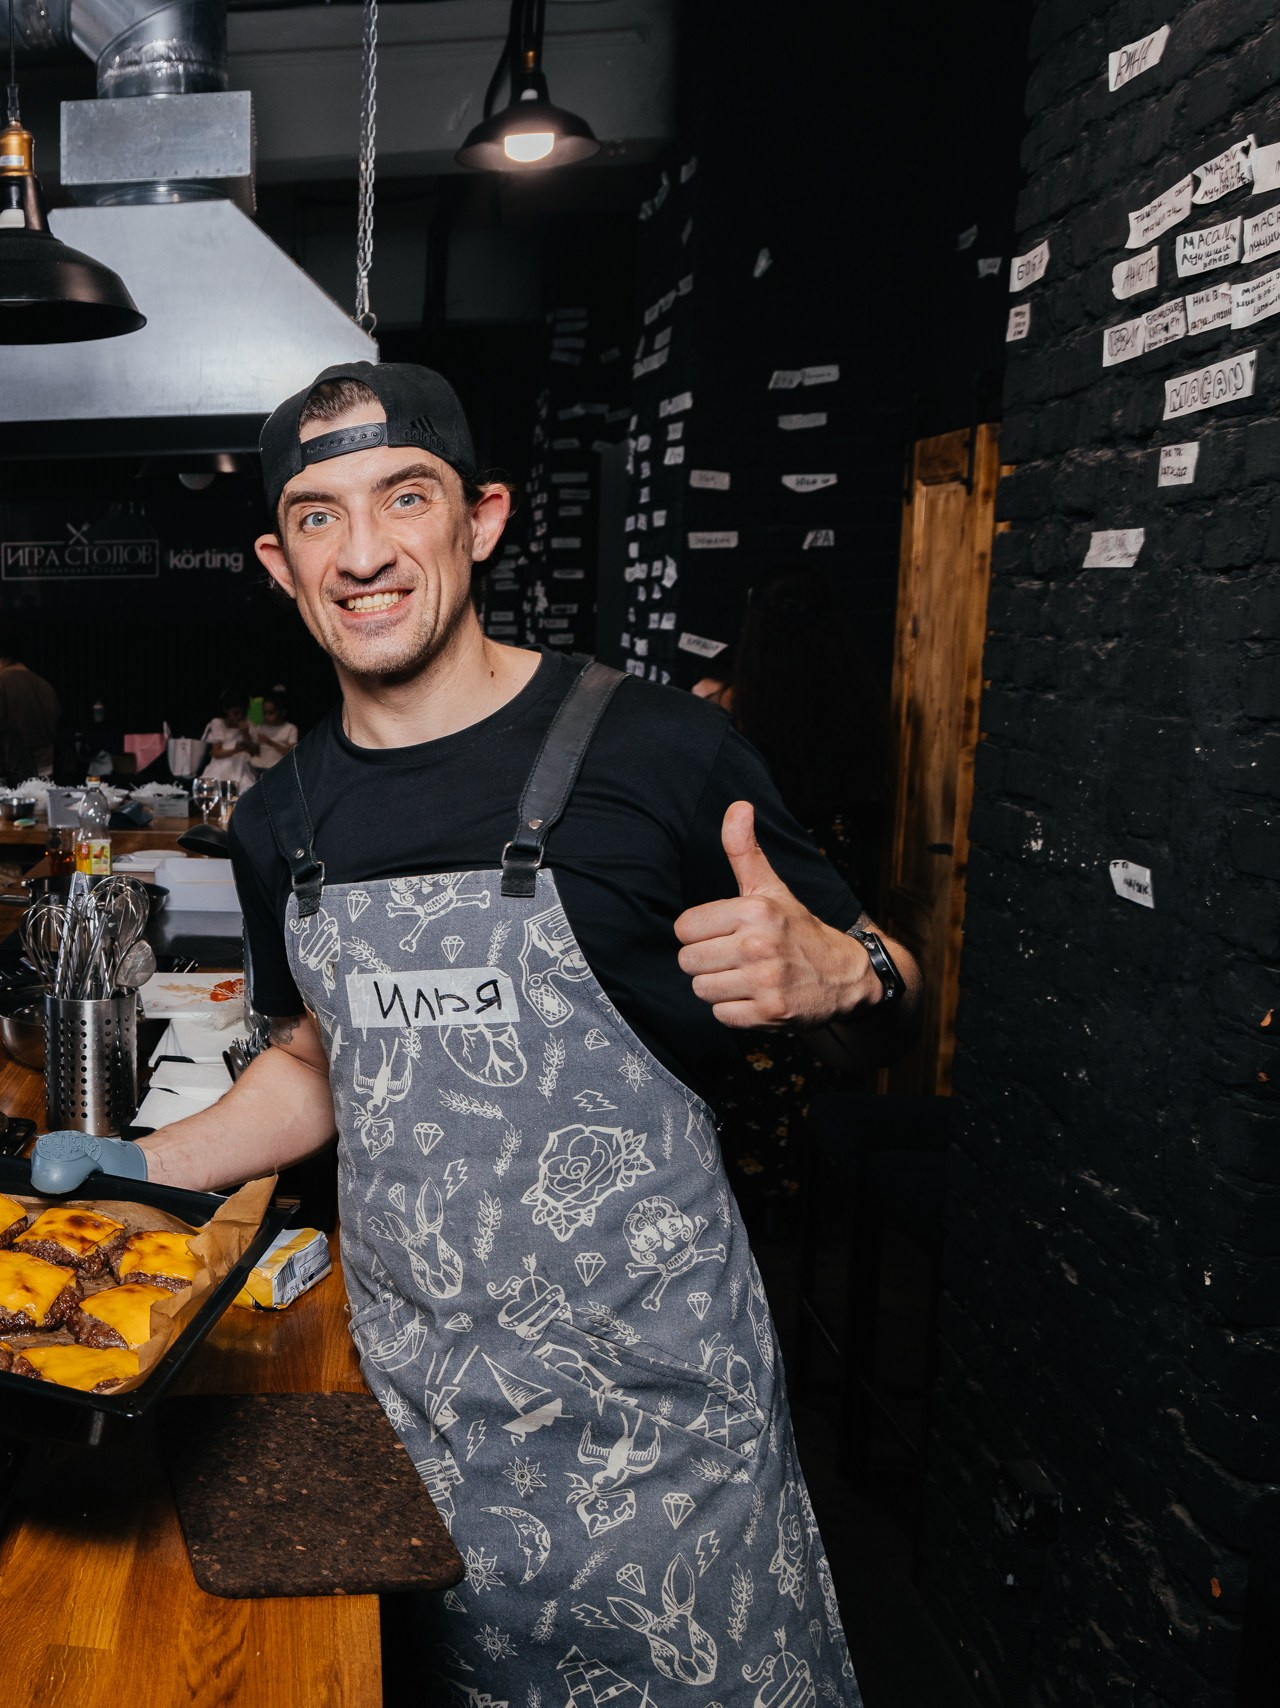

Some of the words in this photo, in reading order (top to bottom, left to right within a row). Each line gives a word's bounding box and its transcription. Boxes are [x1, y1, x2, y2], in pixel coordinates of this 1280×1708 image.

[7, 547, 60, 566] ИГРА
[64, 544, 153, 565] СТОЛОВ
[169, 549, 243, 572] körting
